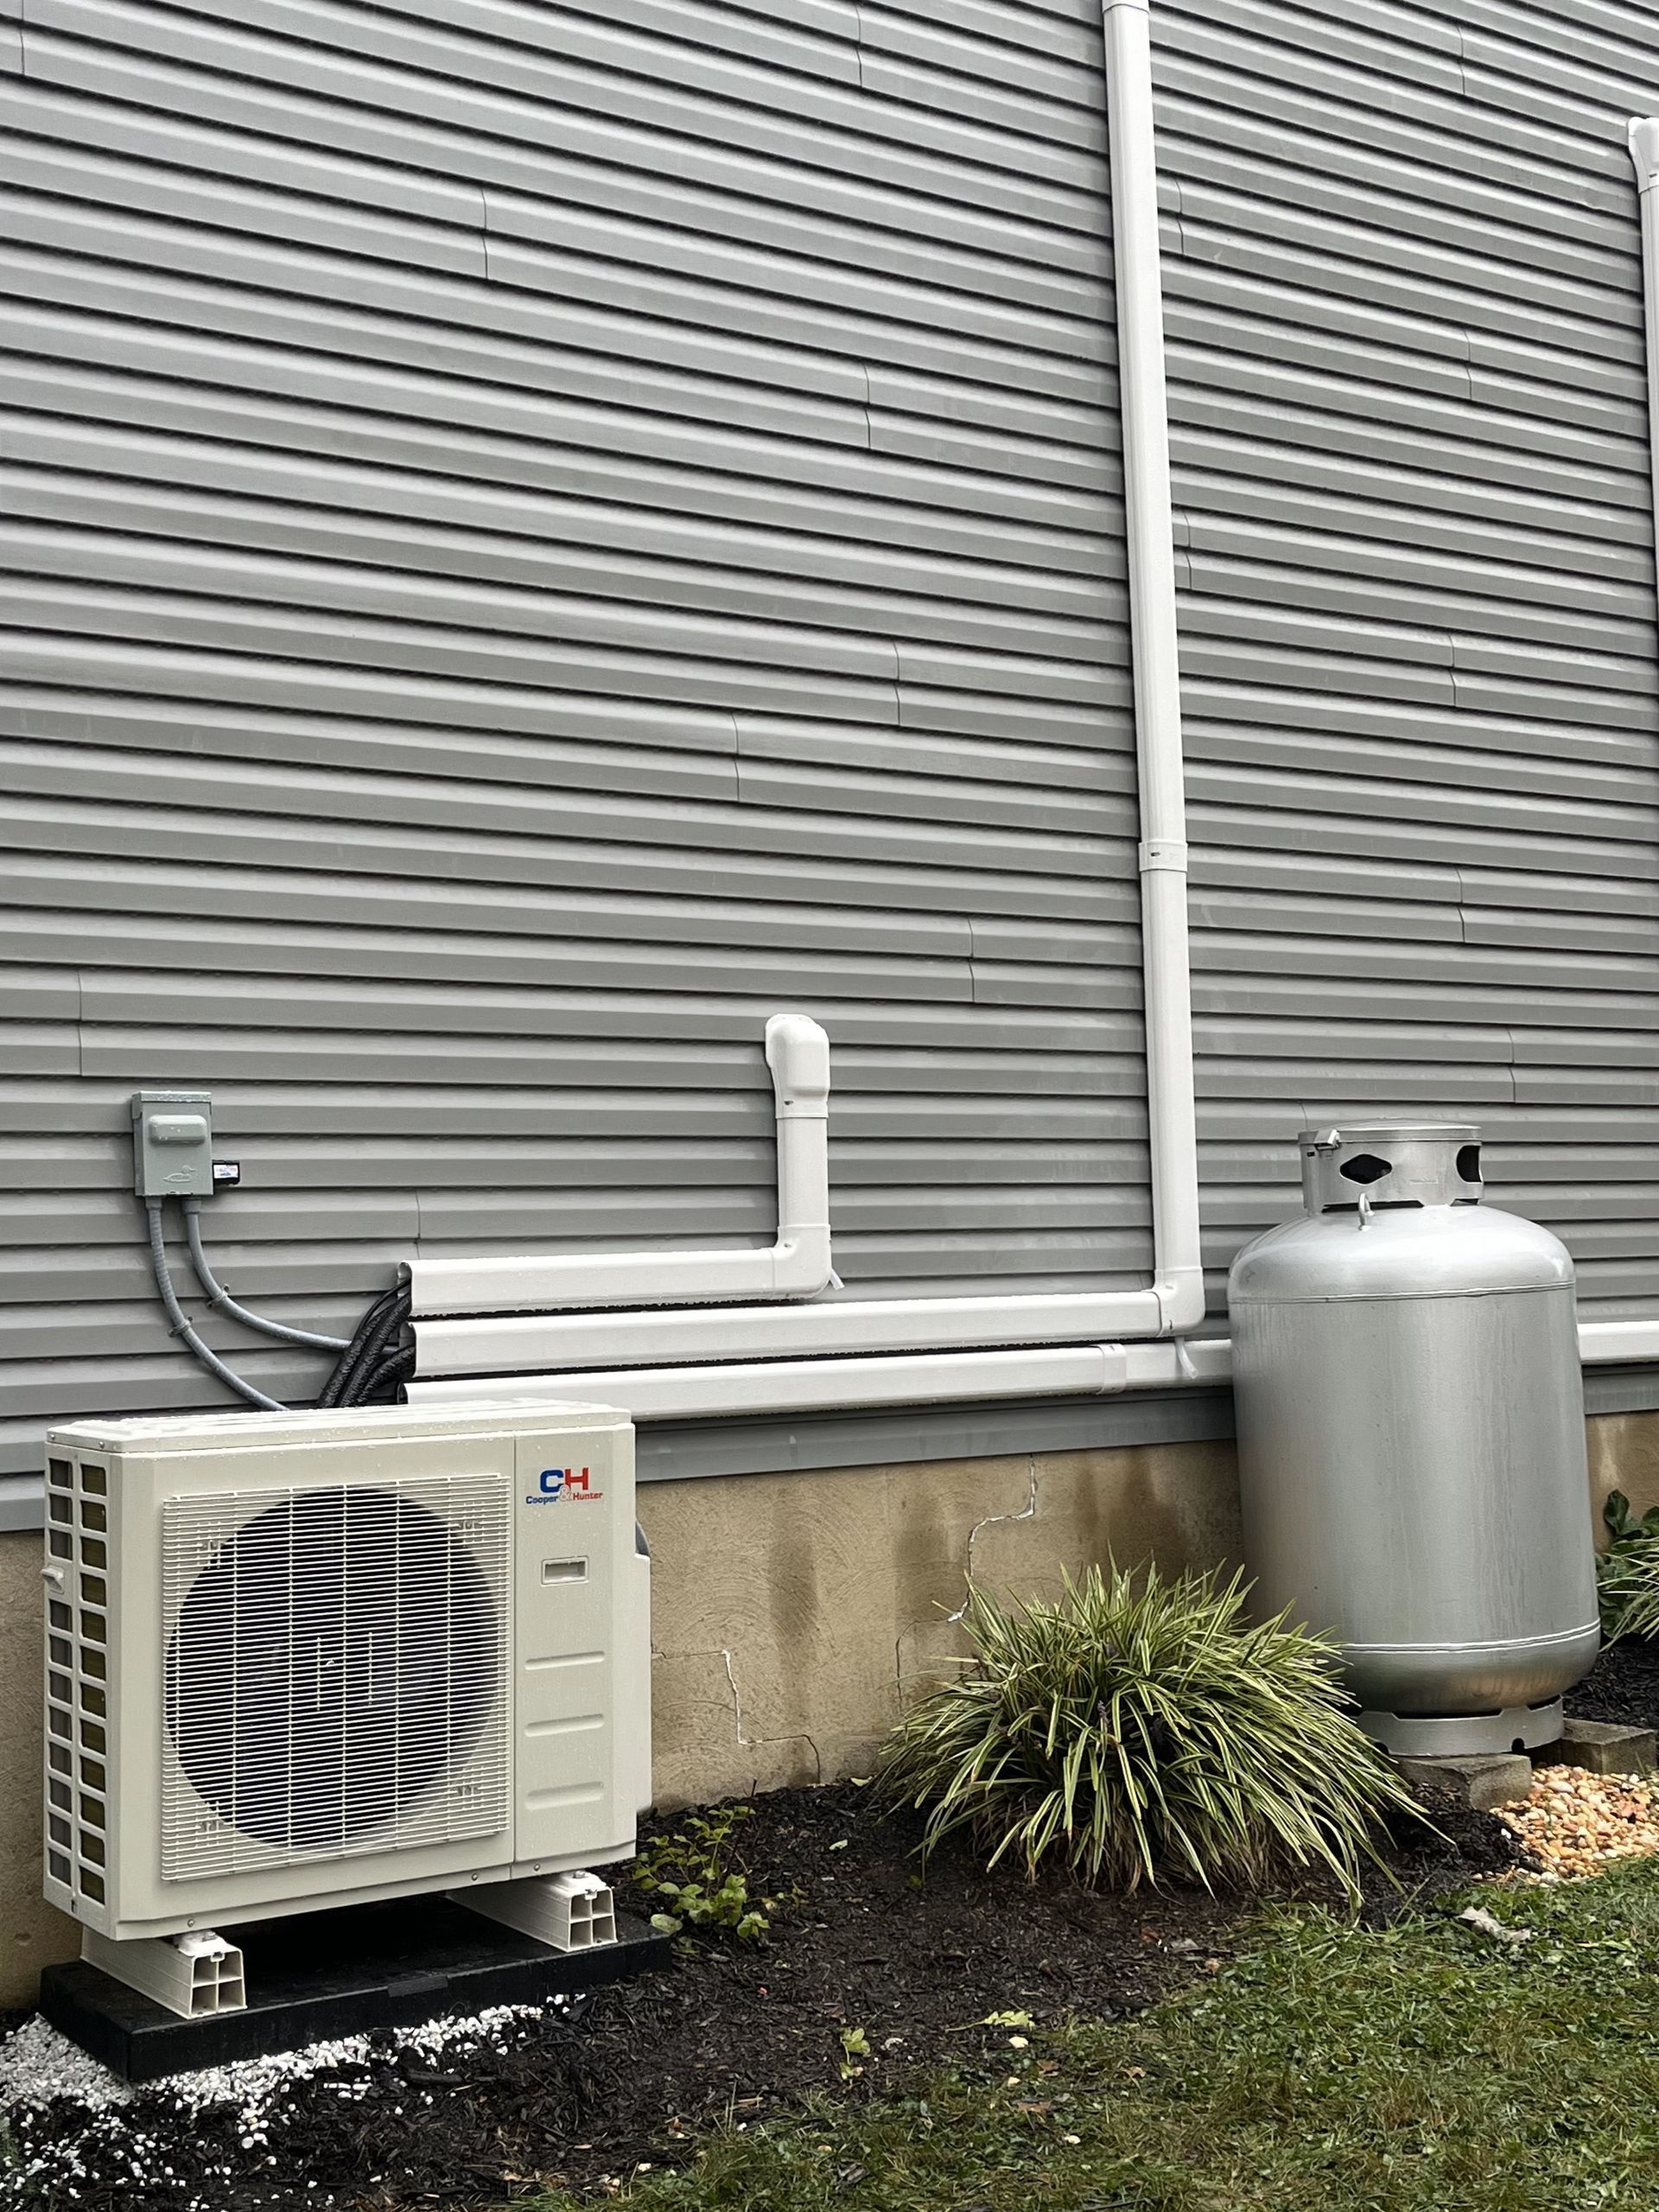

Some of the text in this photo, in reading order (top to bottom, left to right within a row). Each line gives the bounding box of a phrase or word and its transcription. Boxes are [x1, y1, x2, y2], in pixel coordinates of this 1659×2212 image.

[540, 1467, 588, 1492] CH
[525, 1496, 558, 1504] Cooper
[558, 1484, 573, 1502] &
